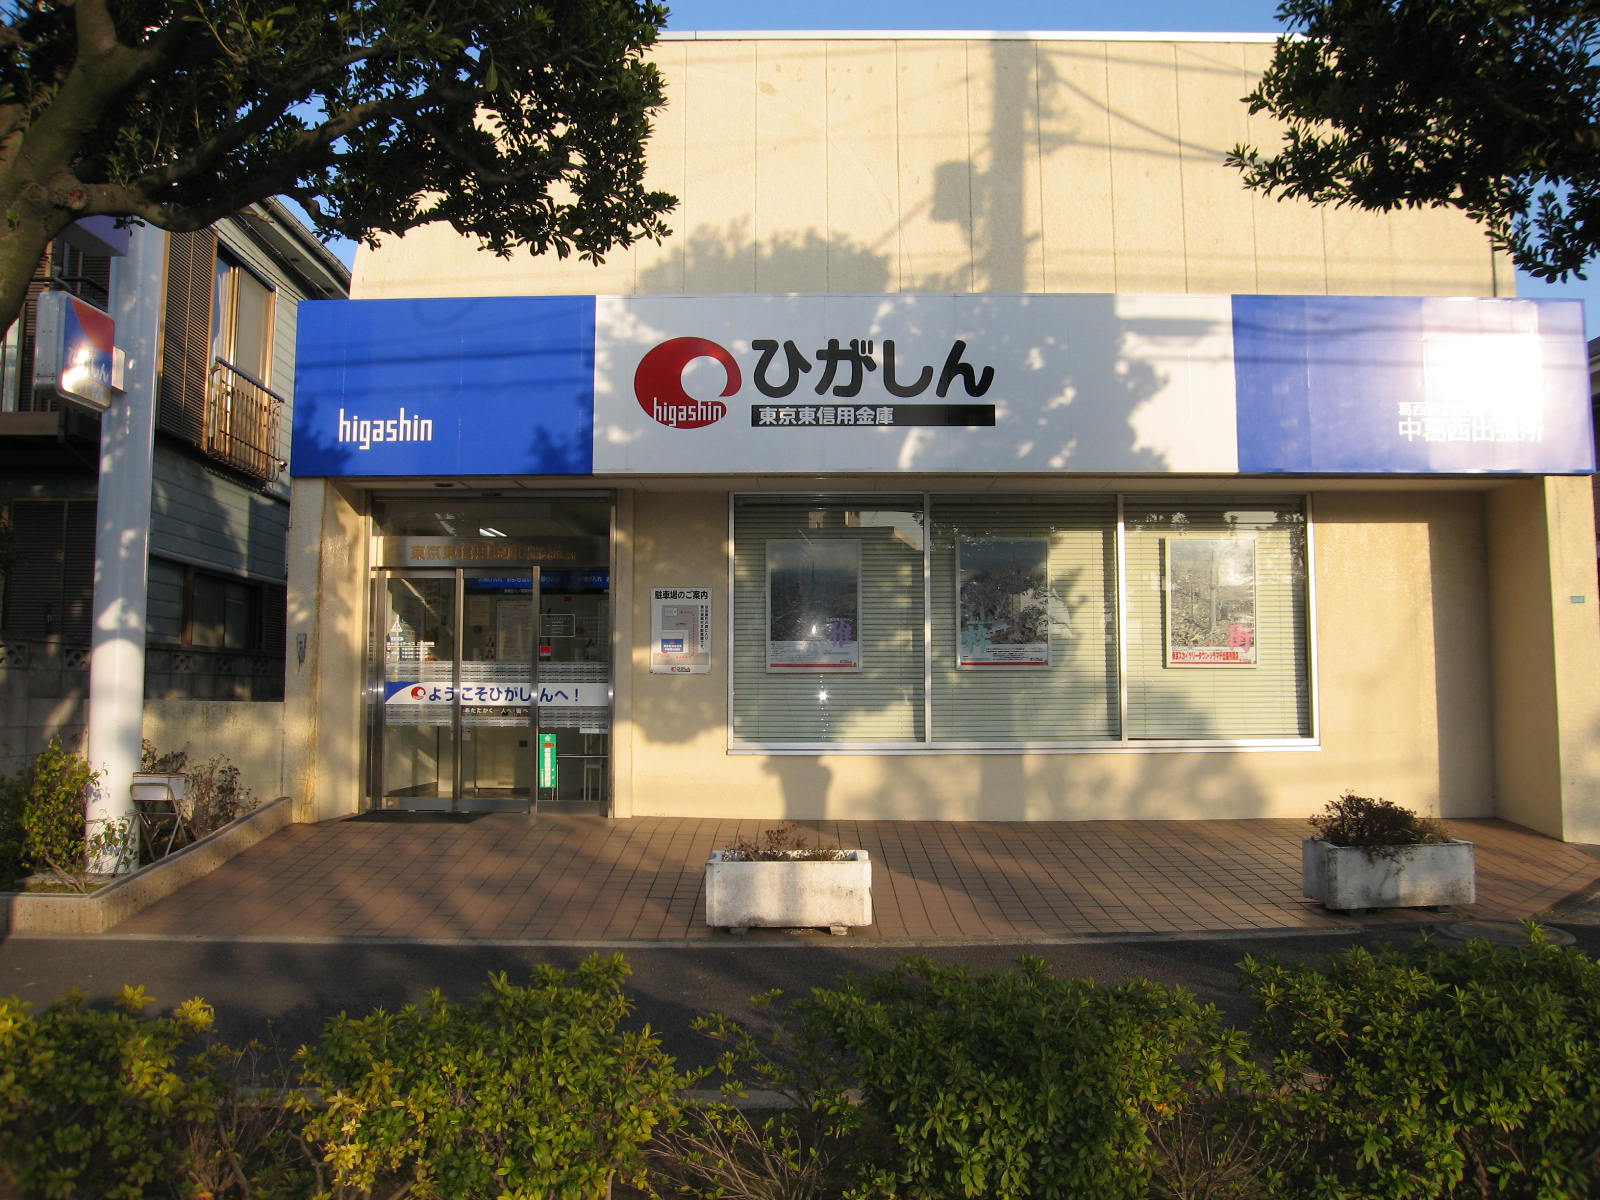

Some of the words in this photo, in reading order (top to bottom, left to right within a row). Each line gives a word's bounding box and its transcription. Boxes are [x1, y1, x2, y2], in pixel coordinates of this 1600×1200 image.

[752, 338, 994, 398] ひがしん
[653, 397, 722, 427] higashin
[758, 405, 895, 426] 東京東信用金庫
[338, 407, 433, 450] higashin
[654, 590, 708, 600] 駐車場のご案内
